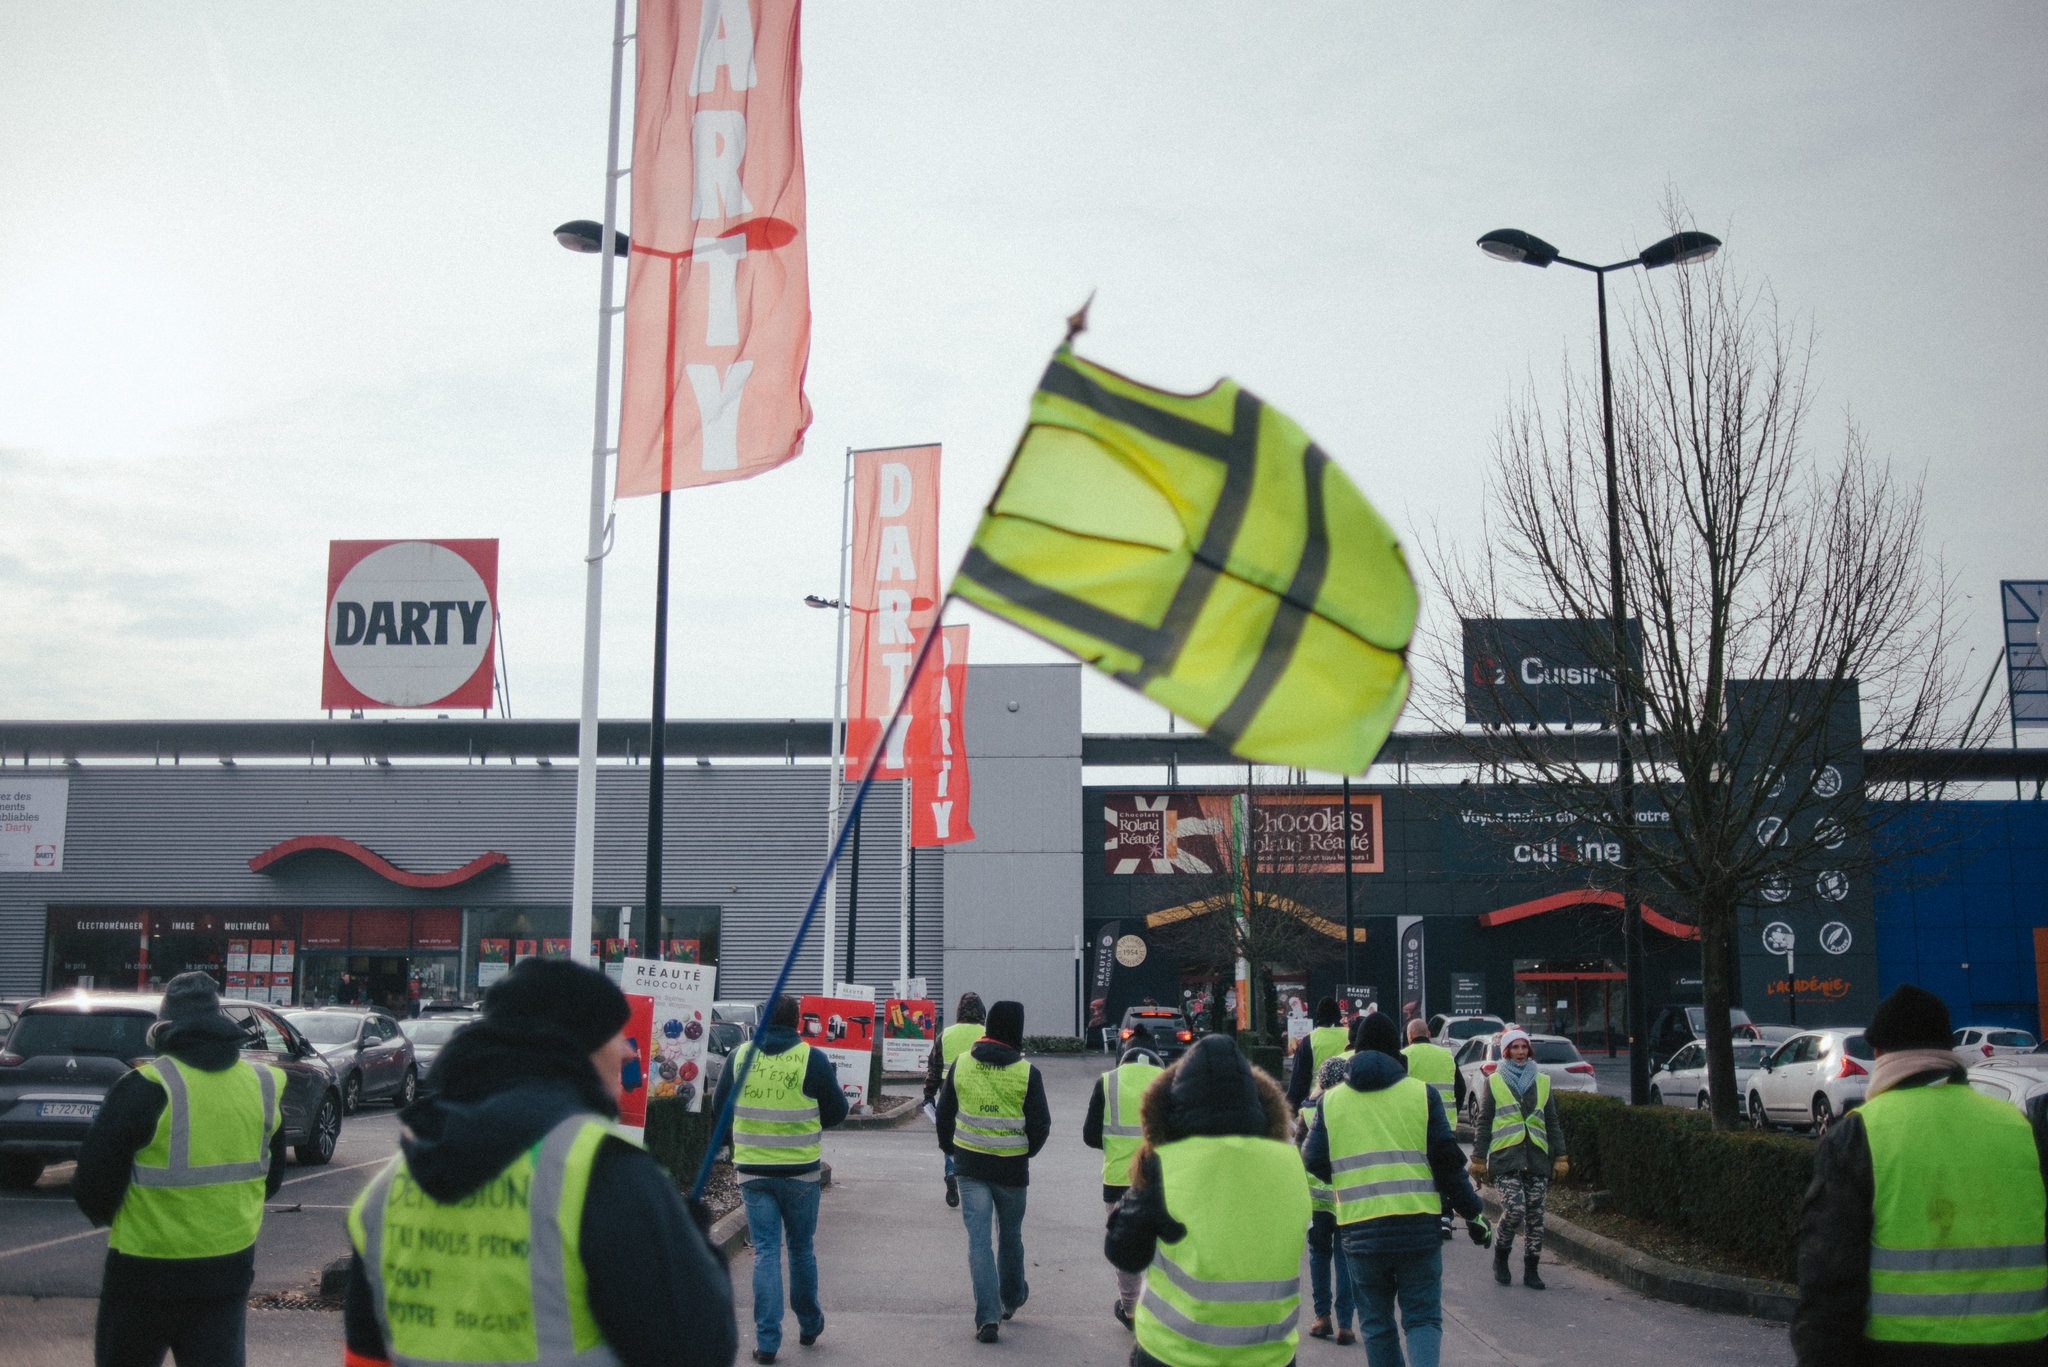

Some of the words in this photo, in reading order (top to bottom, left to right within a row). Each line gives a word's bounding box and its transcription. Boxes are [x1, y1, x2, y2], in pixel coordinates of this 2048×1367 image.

[875, 462, 917, 769] DARTY
[335, 600, 487, 646] DARTY
[14, 792, 32, 801] des
[5, 823, 32, 833] Darty
[1120, 819, 1160, 832] Roland
[1120, 831, 1160, 845] Réauté
[1513, 836, 1621, 863] cuisine
[77, 920, 144, 930] ÉLECTROMÉNAGER
[172, 922, 195, 930] IMAGE
[224, 921, 270, 930] MULTIMÉDIA
[637, 964, 701, 982] RÉAUTÉ
[1097, 948, 1107, 986] RÉAUTÉ
[1406, 952, 1414, 990] RÉAUTÉ
[635, 978, 700, 992] CHOCOLAT
[1346, 986, 1370, 994] RÉAUTÉ
[744, 1085, 785, 1100] FOUTU
[980, 1104, 1000, 1113] POUR
